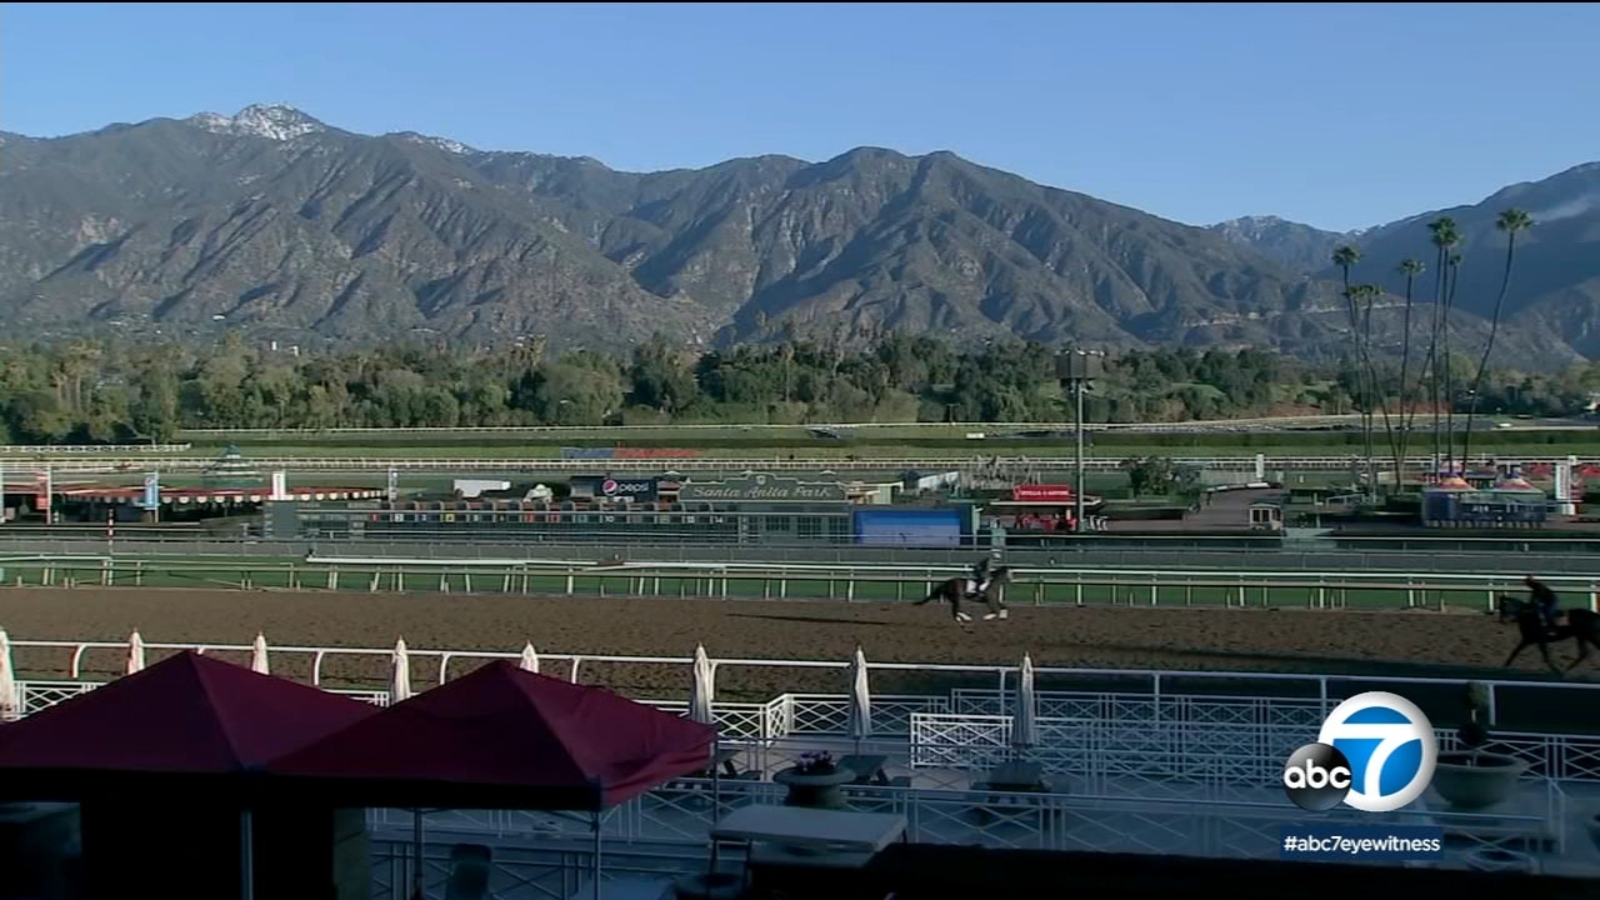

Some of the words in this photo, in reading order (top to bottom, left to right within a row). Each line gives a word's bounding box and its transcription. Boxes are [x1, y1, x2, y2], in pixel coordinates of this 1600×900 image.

[618, 483, 649, 494] pepsi
[693, 486, 740, 497] Santa
[744, 485, 788, 498] Anita
[793, 485, 832, 498] Park
[604, 515, 614, 523] 10
